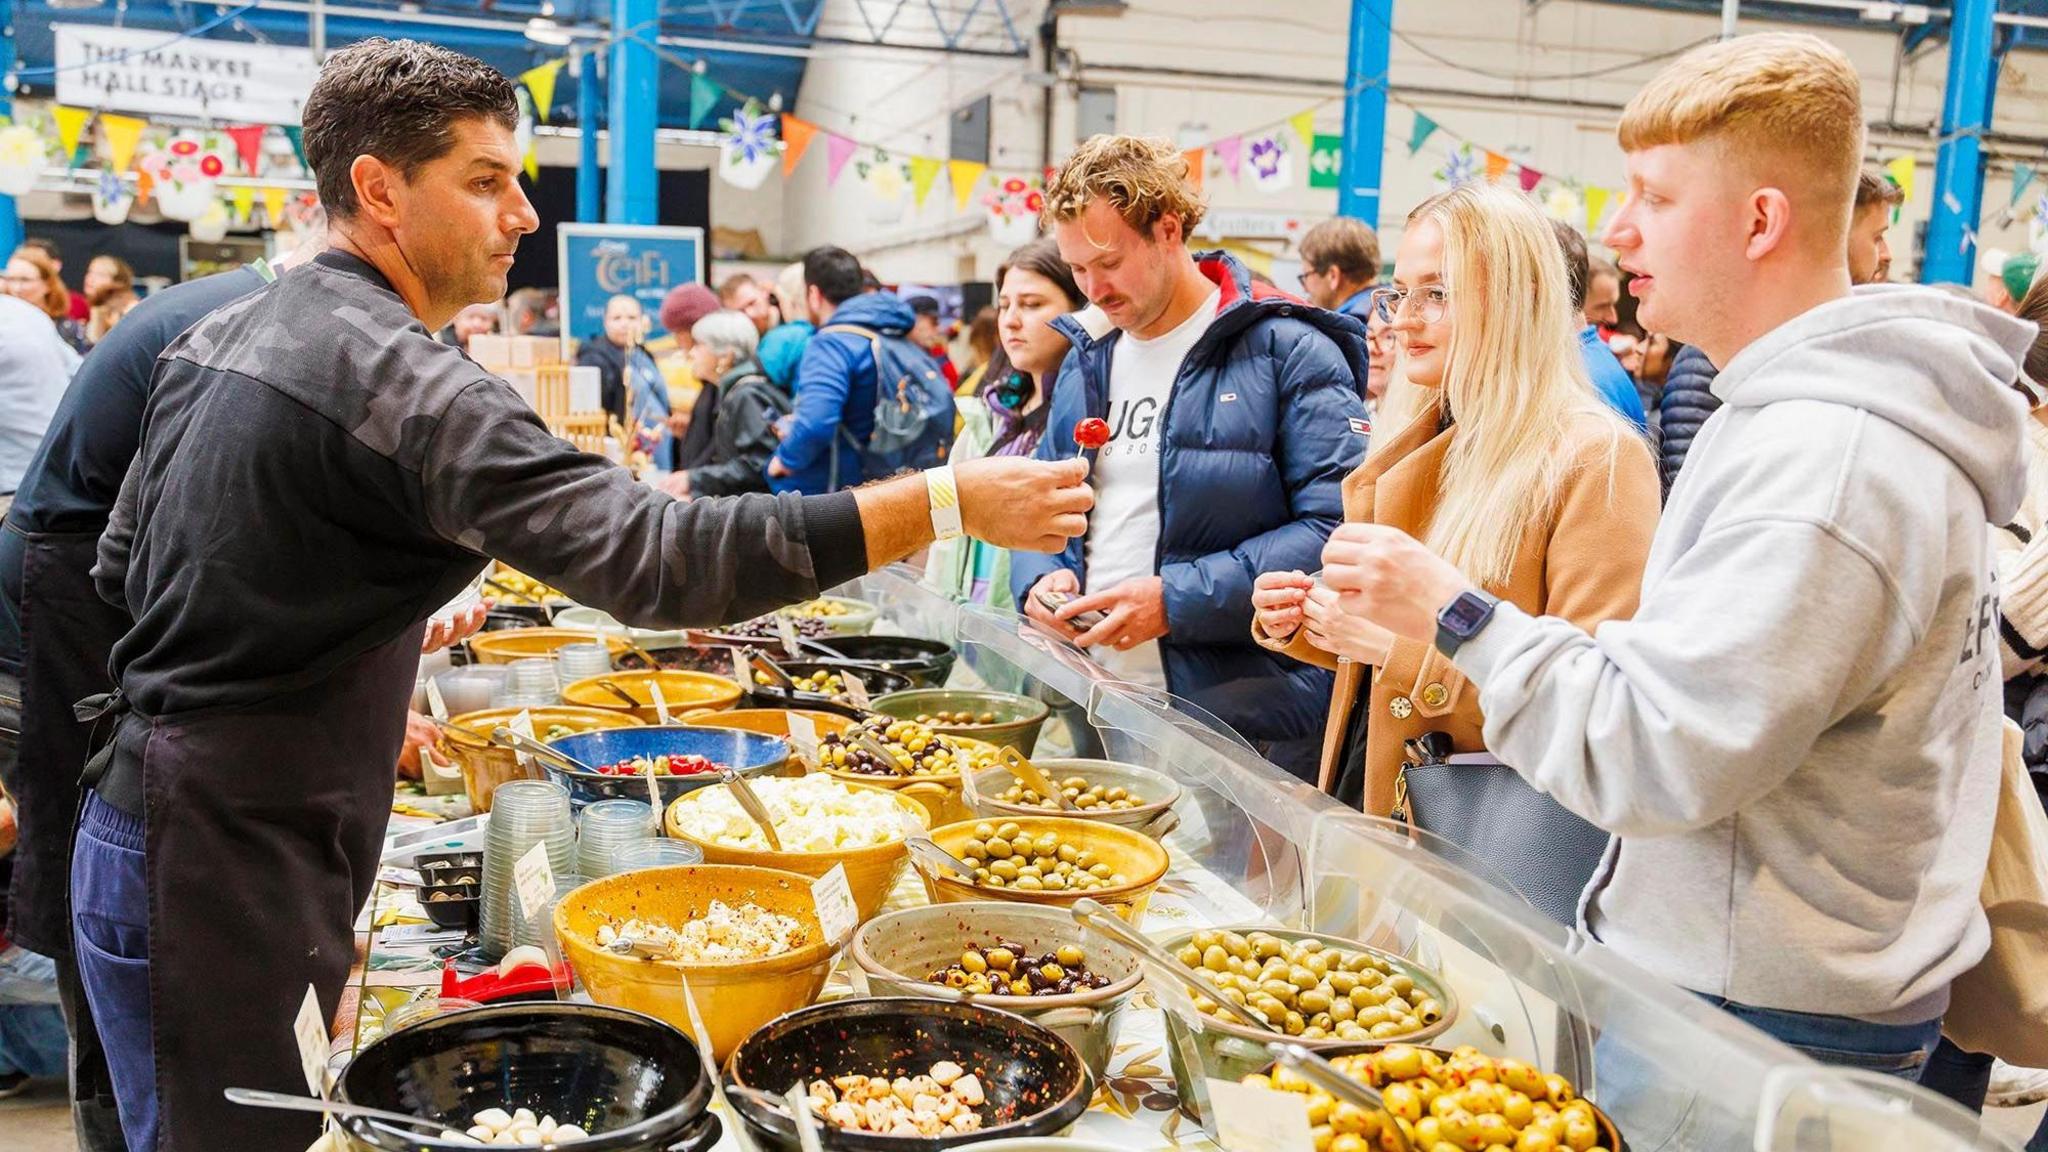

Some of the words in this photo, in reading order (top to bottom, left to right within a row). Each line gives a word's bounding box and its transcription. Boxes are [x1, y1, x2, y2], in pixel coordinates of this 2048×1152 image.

[82, 43, 129, 66] THE
[142, 50, 252, 78] MARKET
[82, 70, 152, 95] HALL
[162, 77, 245, 101] STAGE
[1104, 396, 1166, 442] UG
